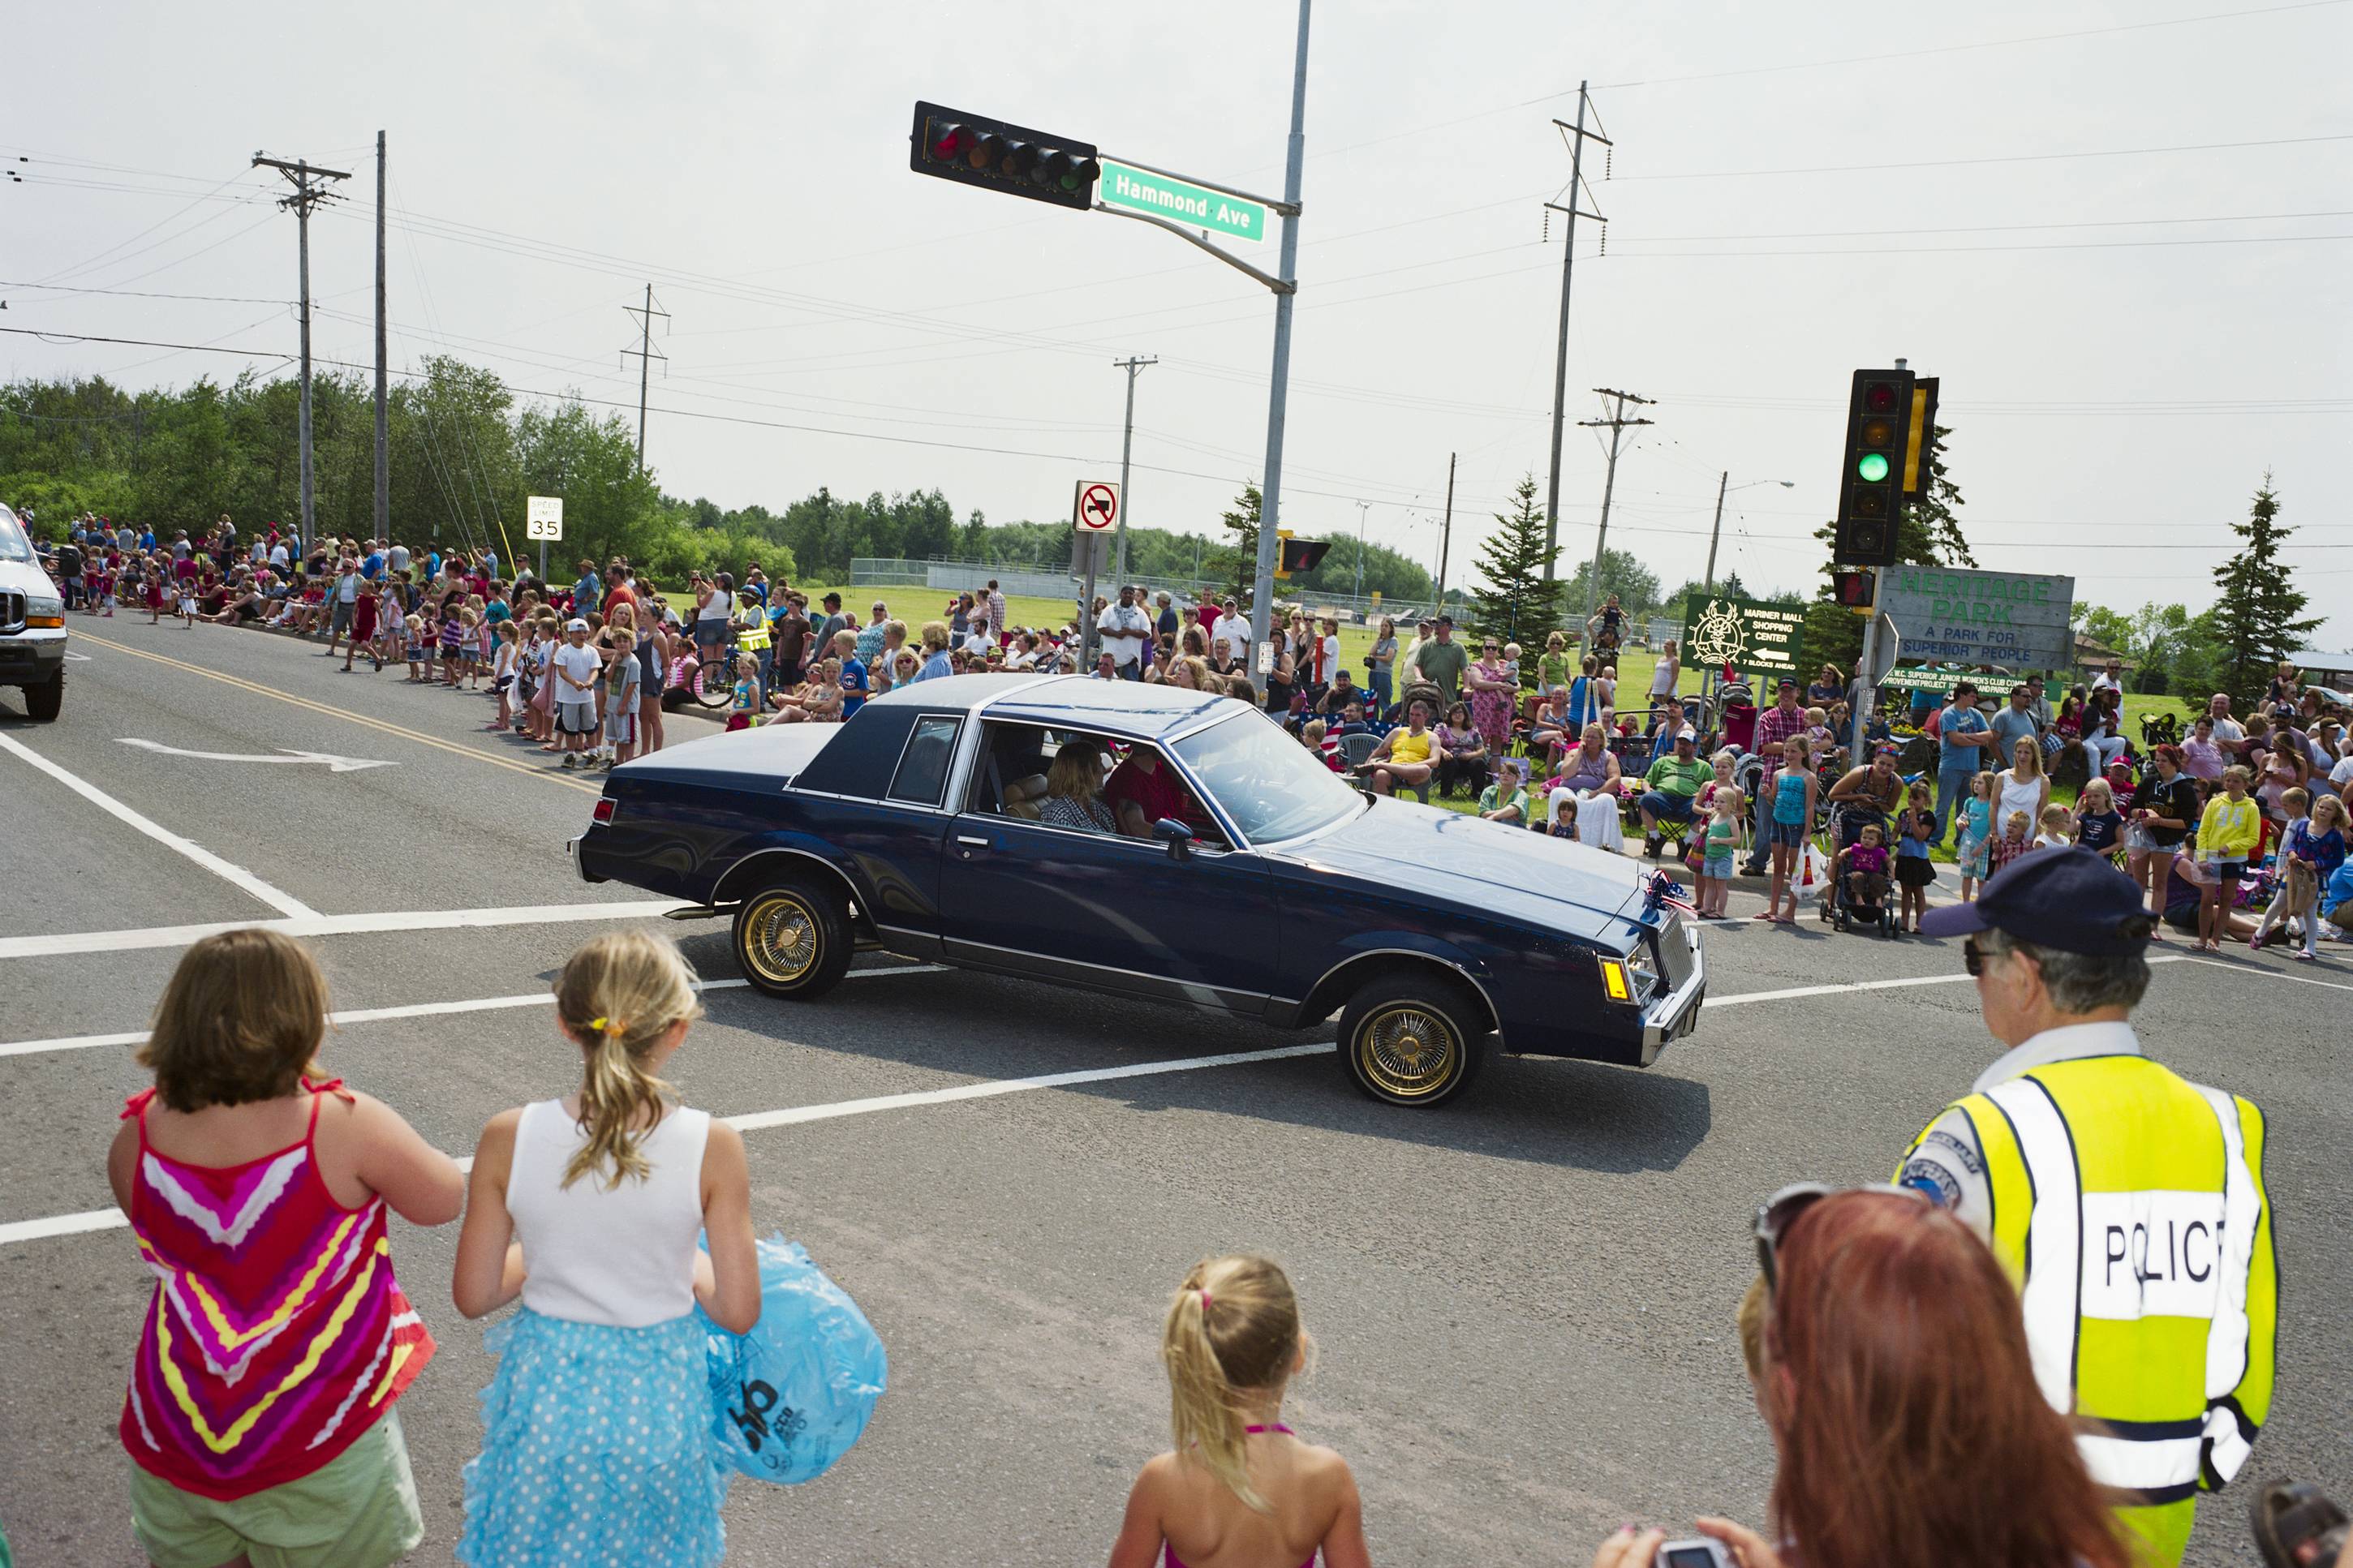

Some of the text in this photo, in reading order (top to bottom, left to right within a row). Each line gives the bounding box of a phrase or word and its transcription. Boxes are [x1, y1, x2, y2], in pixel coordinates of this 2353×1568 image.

[1116, 174, 1250, 228] Hammond Ave
[532, 500, 559, 509] SPEED
[532, 520, 557, 535] 35
[1900, 571, 2051, 607] HERITAGE
[1744, 608, 1804, 623] MARINER MALL
[1931, 599, 2014, 629] PARK
[1753, 621, 1793, 633] SHOPPING
[1755, 631, 1787, 642] CENTER
[1925, 626, 2014, 644] A PARK FOR
[1903, 639, 2031, 662] SUPERIOR PEOPLE
[1749, 659, 1774, 668] BLOCKS
[1774, 662, 1796, 670] AHEAD
[1908, 671, 1938, 681] SUPERIOR
[1938, 673, 1960, 682] JUNIOR
[1962, 676, 1990, 685] WOMEN'S
[1990, 677, 2006, 685] CLUB
[1921, 680, 1946, 689] PROJECT
[1990, 685, 2009, 694] PARKS
